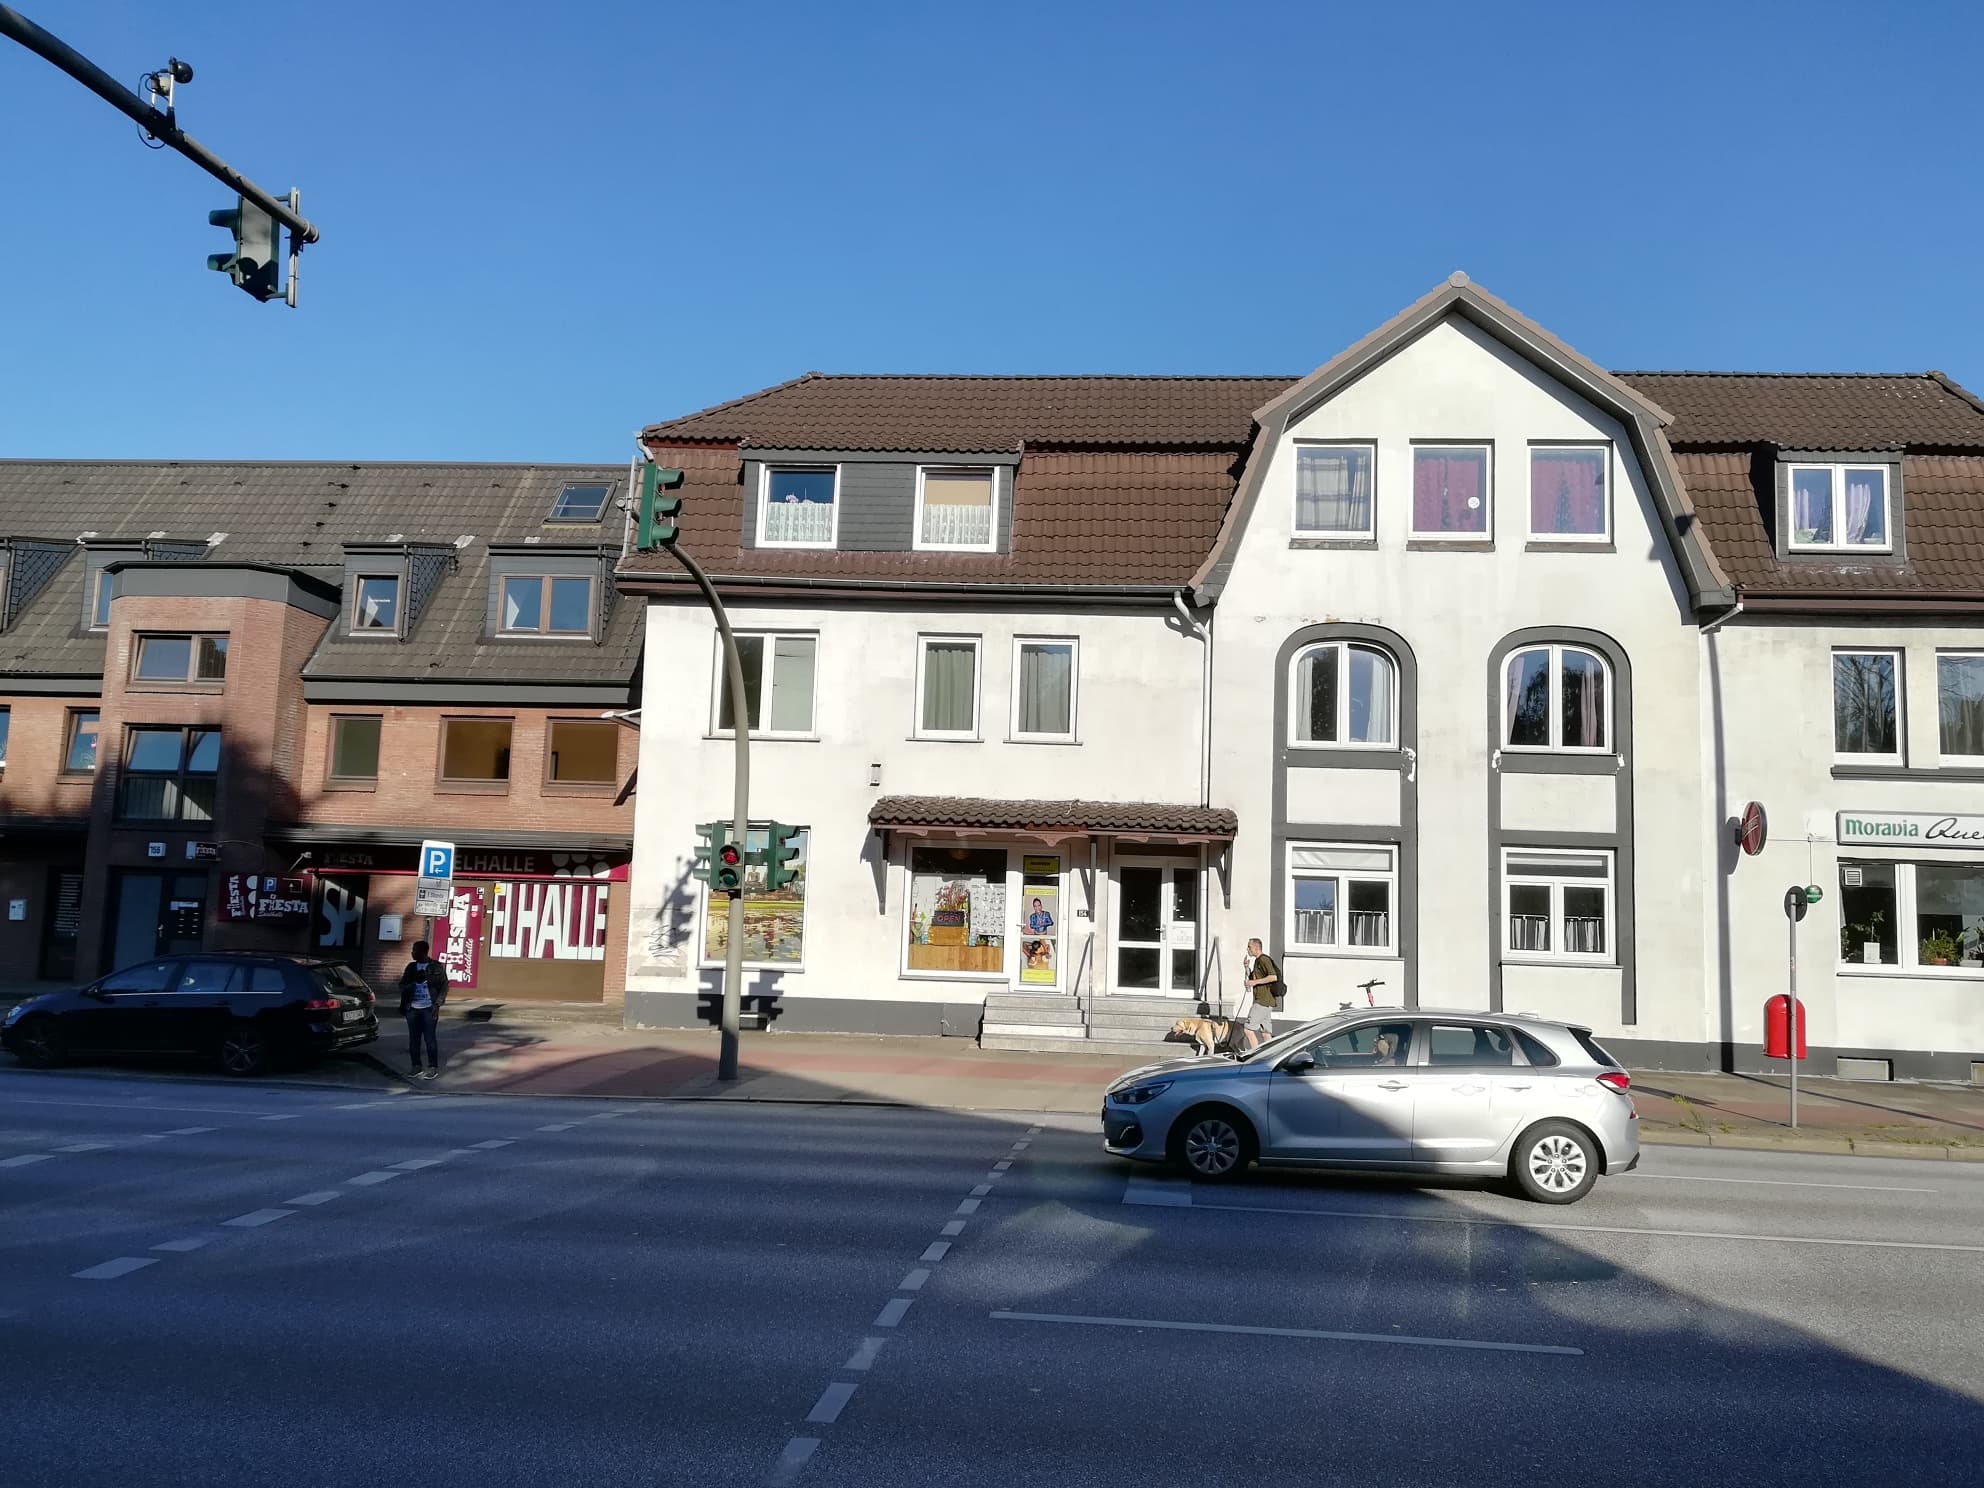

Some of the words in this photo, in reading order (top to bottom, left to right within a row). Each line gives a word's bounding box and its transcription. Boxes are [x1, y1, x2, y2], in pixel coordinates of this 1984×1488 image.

[1845, 819, 1919, 837] Moravia
[1925, 817, 1984, 840] Que
[429, 850, 446, 874] P
[259, 897, 309, 914] FIESTA
[936, 914, 961, 923] OPEN
[443, 893, 470, 982] FIESTA
[463, 938, 474, 983] Spielhalle
